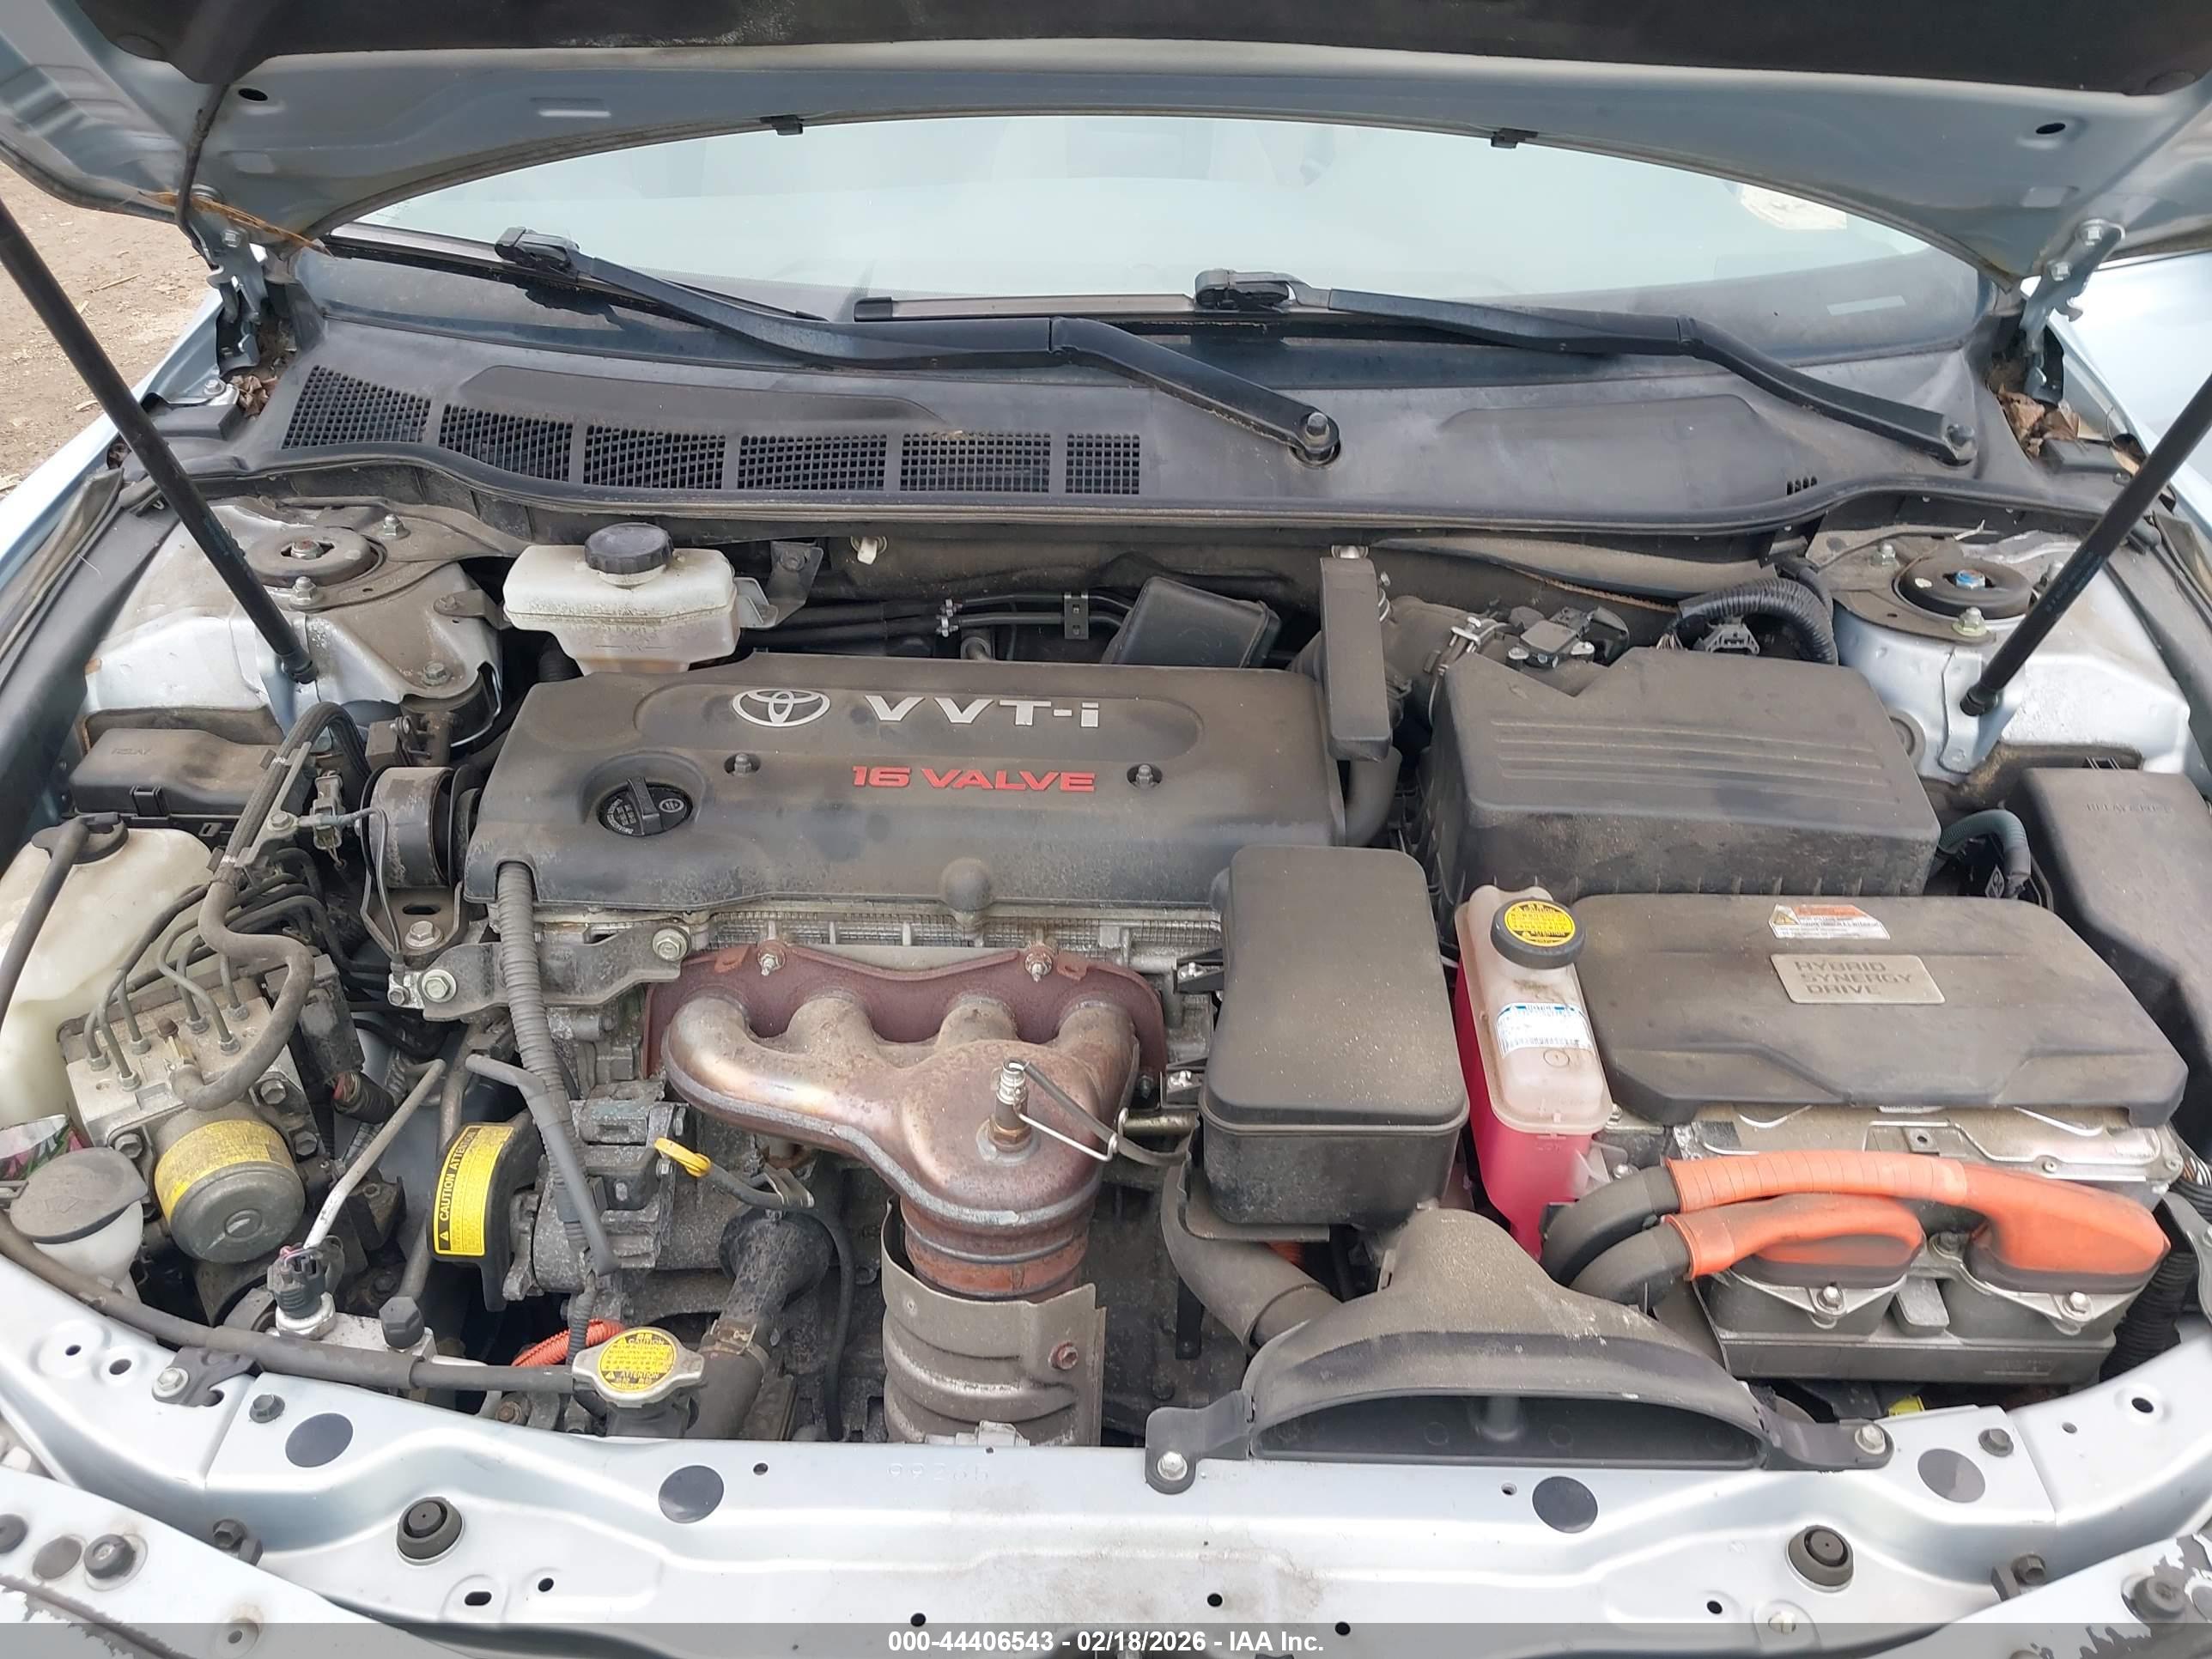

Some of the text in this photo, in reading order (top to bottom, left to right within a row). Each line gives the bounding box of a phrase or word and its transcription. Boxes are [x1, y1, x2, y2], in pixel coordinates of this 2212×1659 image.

[864, 694, 1100, 728] VVT-i
[853, 766, 1096, 792] 16 VALVE
[1795, 961, 1887, 971] HYBRID
[1801, 973, 1912, 983] SYNERGY
[1806, 984, 1881, 994] DRIVE
[439, 1173, 455, 1221] CAUTION
[449, 1131, 477, 1170] ATTENTION
[621, 1370, 659, 1379] ATTENTION
